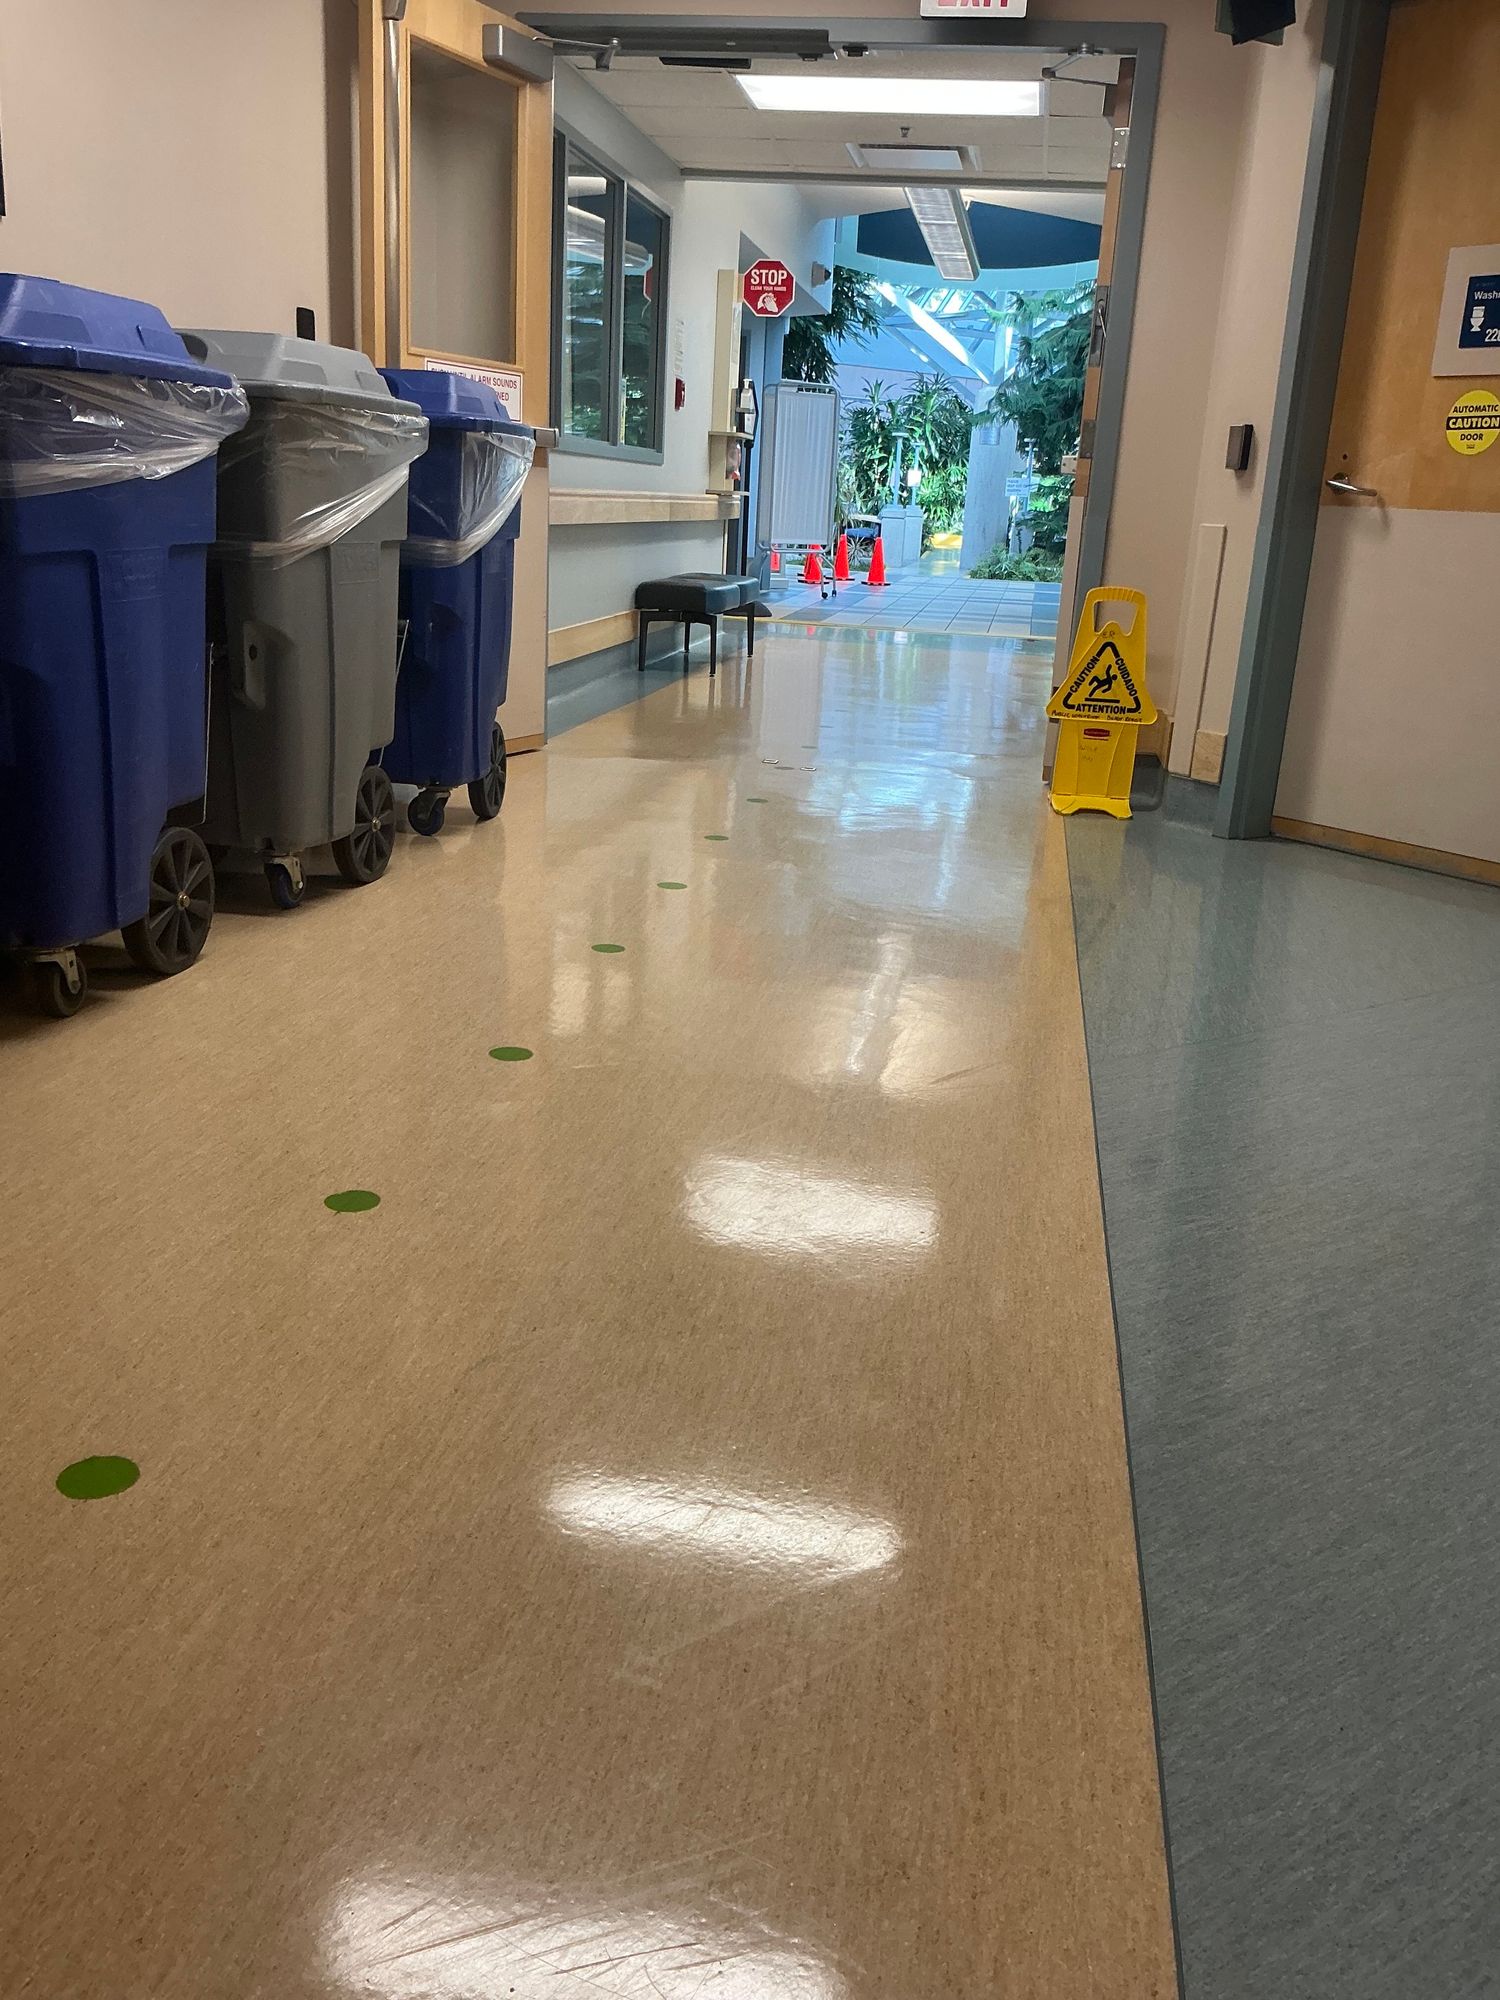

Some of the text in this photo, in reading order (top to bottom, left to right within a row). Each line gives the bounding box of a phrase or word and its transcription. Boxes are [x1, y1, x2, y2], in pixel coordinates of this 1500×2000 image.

[751, 269, 787, 285] STOP
[492, 377, 518, 389] SOUNDS
[1452, 404, 1499, 413] AUTOMATIC
[1449, 417, 1500, 428] CAUTION
[1460, 433, 1484, 441] DOOR
[1069, 656, 1100, 693] CAUTION
[1115, 657, 1138, 697] CUIDADO
[1075, 704, 1127, 714] ATTENTION
